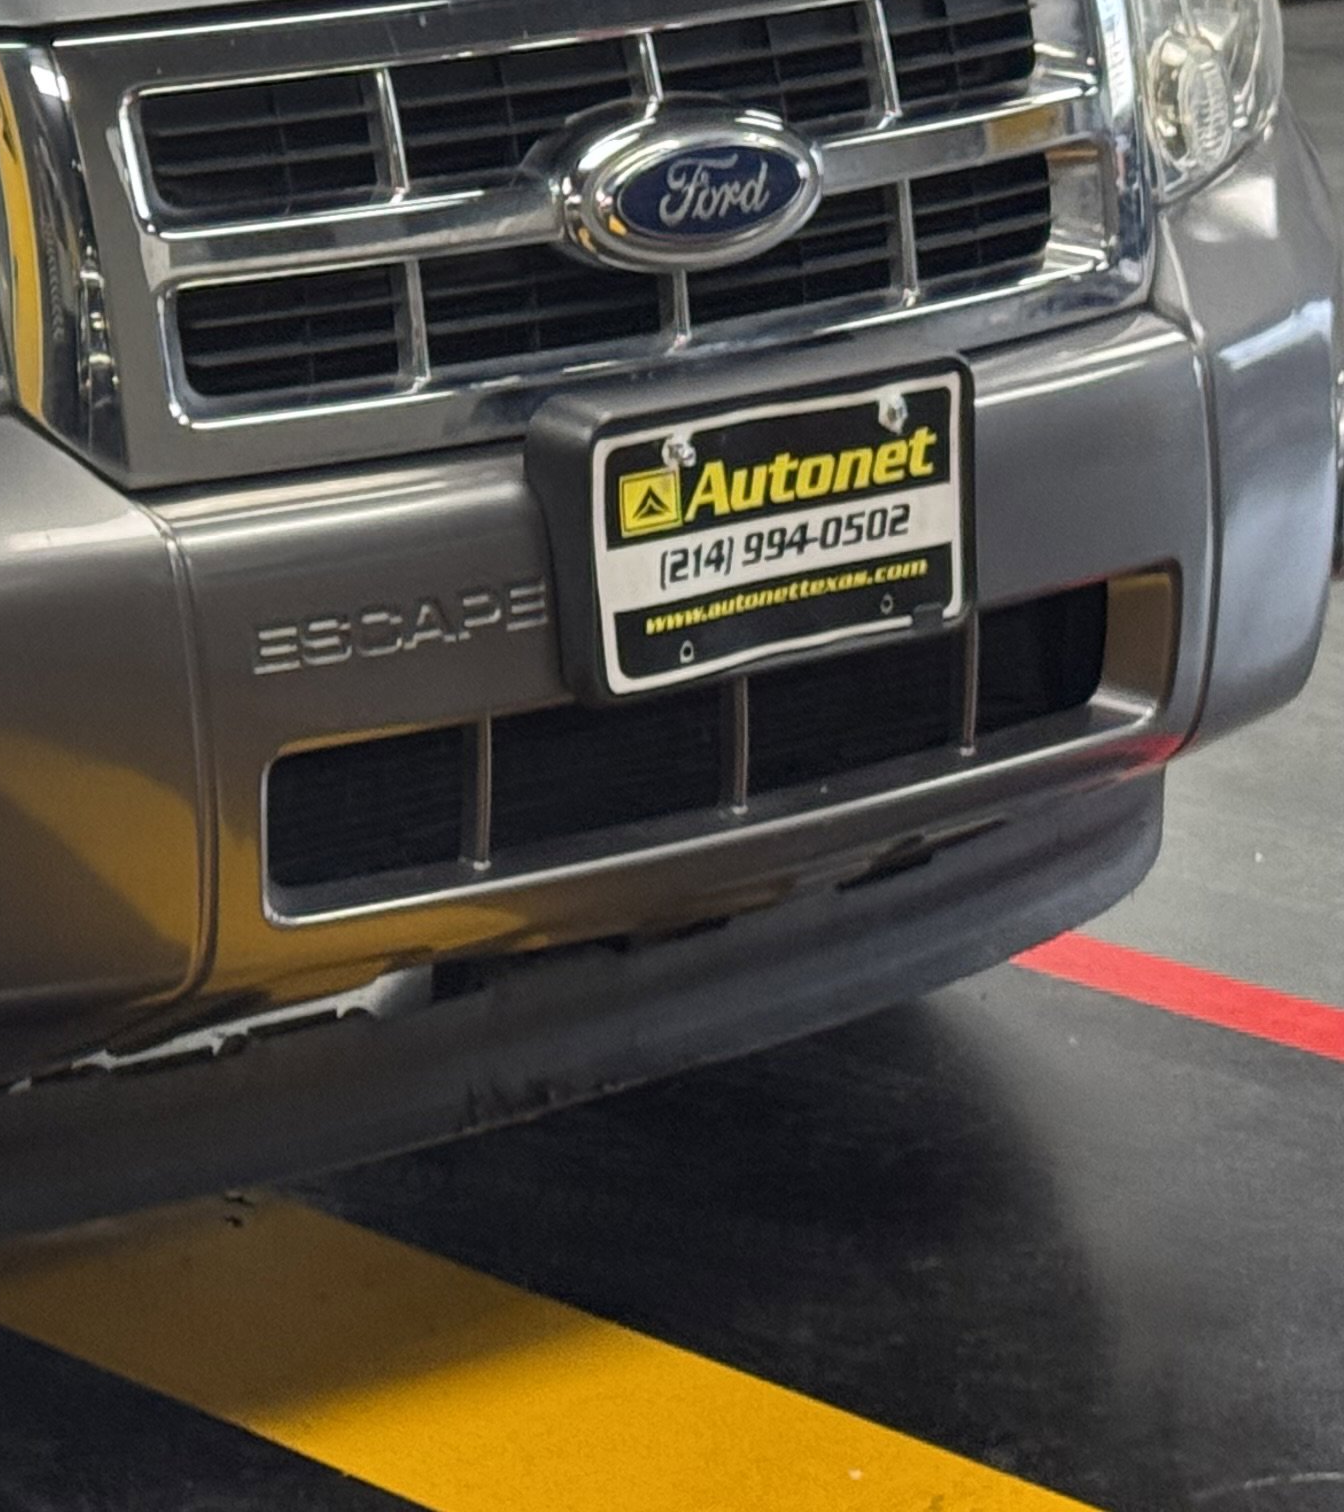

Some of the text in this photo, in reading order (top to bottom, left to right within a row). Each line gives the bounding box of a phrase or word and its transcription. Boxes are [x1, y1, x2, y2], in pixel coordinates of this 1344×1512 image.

[659, 153, 770, 226] Ford
[684, 426, 937, 522] Autonet
[660, 503, 911, 590] (214) 994-0502
[254, 579, 548, 675] ESCAPE
[645, 558, 928, 635] www.autonettexas.com
